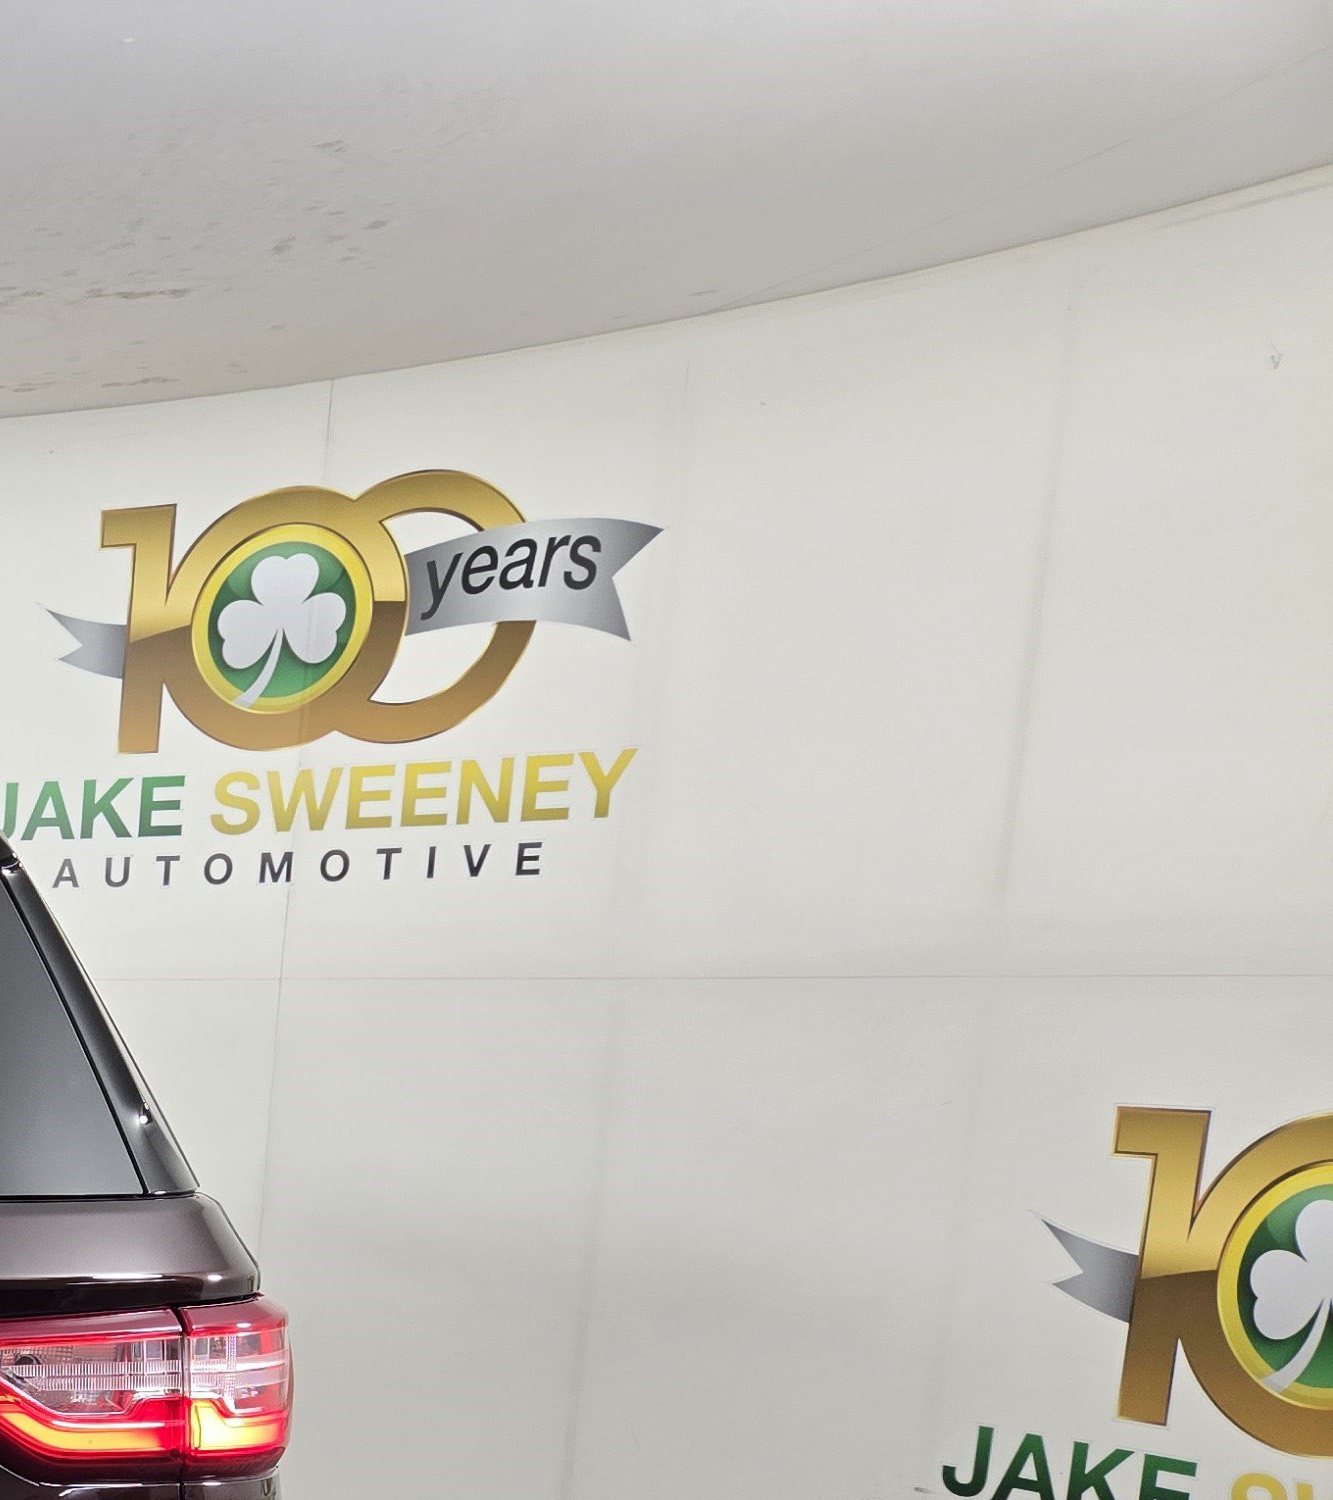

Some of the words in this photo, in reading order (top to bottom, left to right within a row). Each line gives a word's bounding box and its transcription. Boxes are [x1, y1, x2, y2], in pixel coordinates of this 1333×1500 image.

[99, 469, 539, 755] 100
[420, 533, 602, 621] years
[2, 774, 186, 841] JAKE
[209, 748, 640, 836] SWEENEY
[51, 841, 544, 890] AUTOMOTIVE
